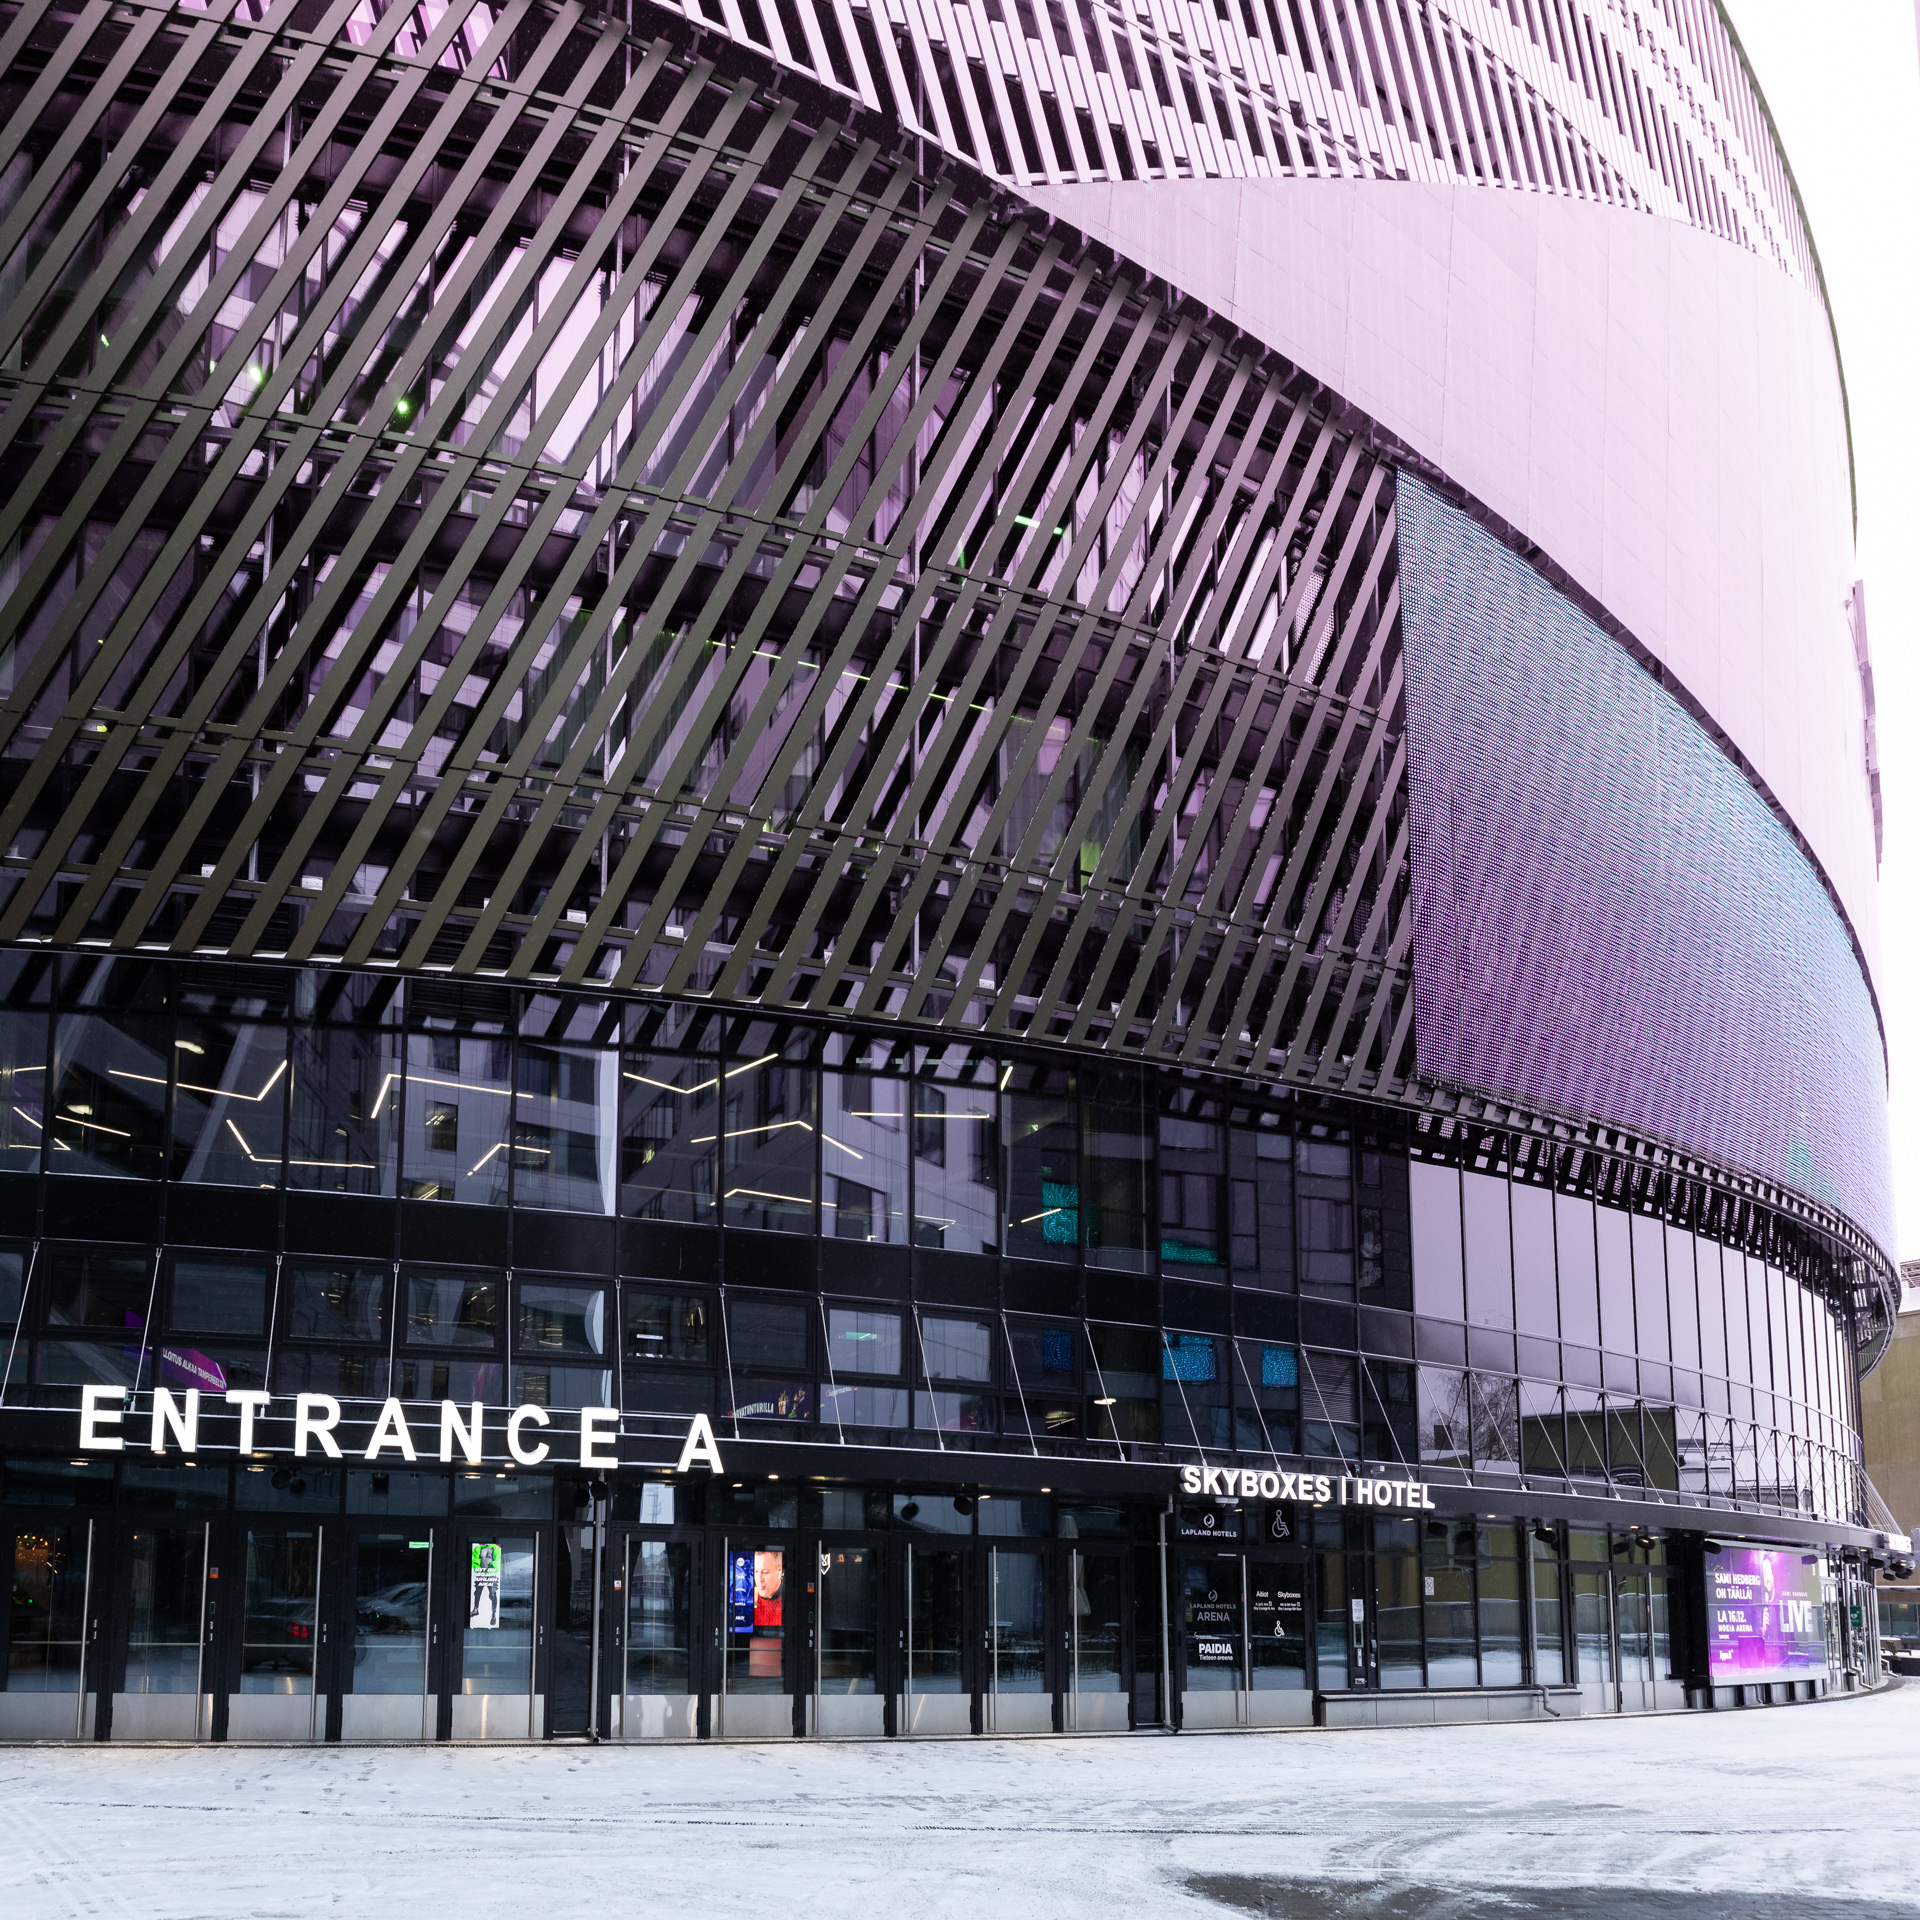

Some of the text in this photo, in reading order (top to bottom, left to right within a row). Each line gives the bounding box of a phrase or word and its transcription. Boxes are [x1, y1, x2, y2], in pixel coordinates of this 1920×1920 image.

[182, 1358, 197, 1375] ALKAA
[731, 1402, 774, 1418] RVATUNTURILLA
[80, 1384, 724, 1474] ENTRANCE A
[1180, 1467, 1331, 1502] SKYBOXES
[1354, 1479, 1435, 1509] HOTEL
[1181, 1528, 1237, 1538] LAPLAND HOTELS
[1715, 1573, 1761, 1586] SAMI HEDBERG
[1277, 1591, 1301, 1599] Skyboxes
[1716, 1586, 1753, 1600] ON TÄÄLLÄ!
[1197, 1612, 1231, 1621] ARENA
[1717, 1610, 1747, 1623] LA 16.12.
[1779, 1600, 1814, 1633] LIVE
[1718, 1624, 1753, 1632] NOKIA ARENA
[1199, 1643, 1233, 1654] PAIDIA
